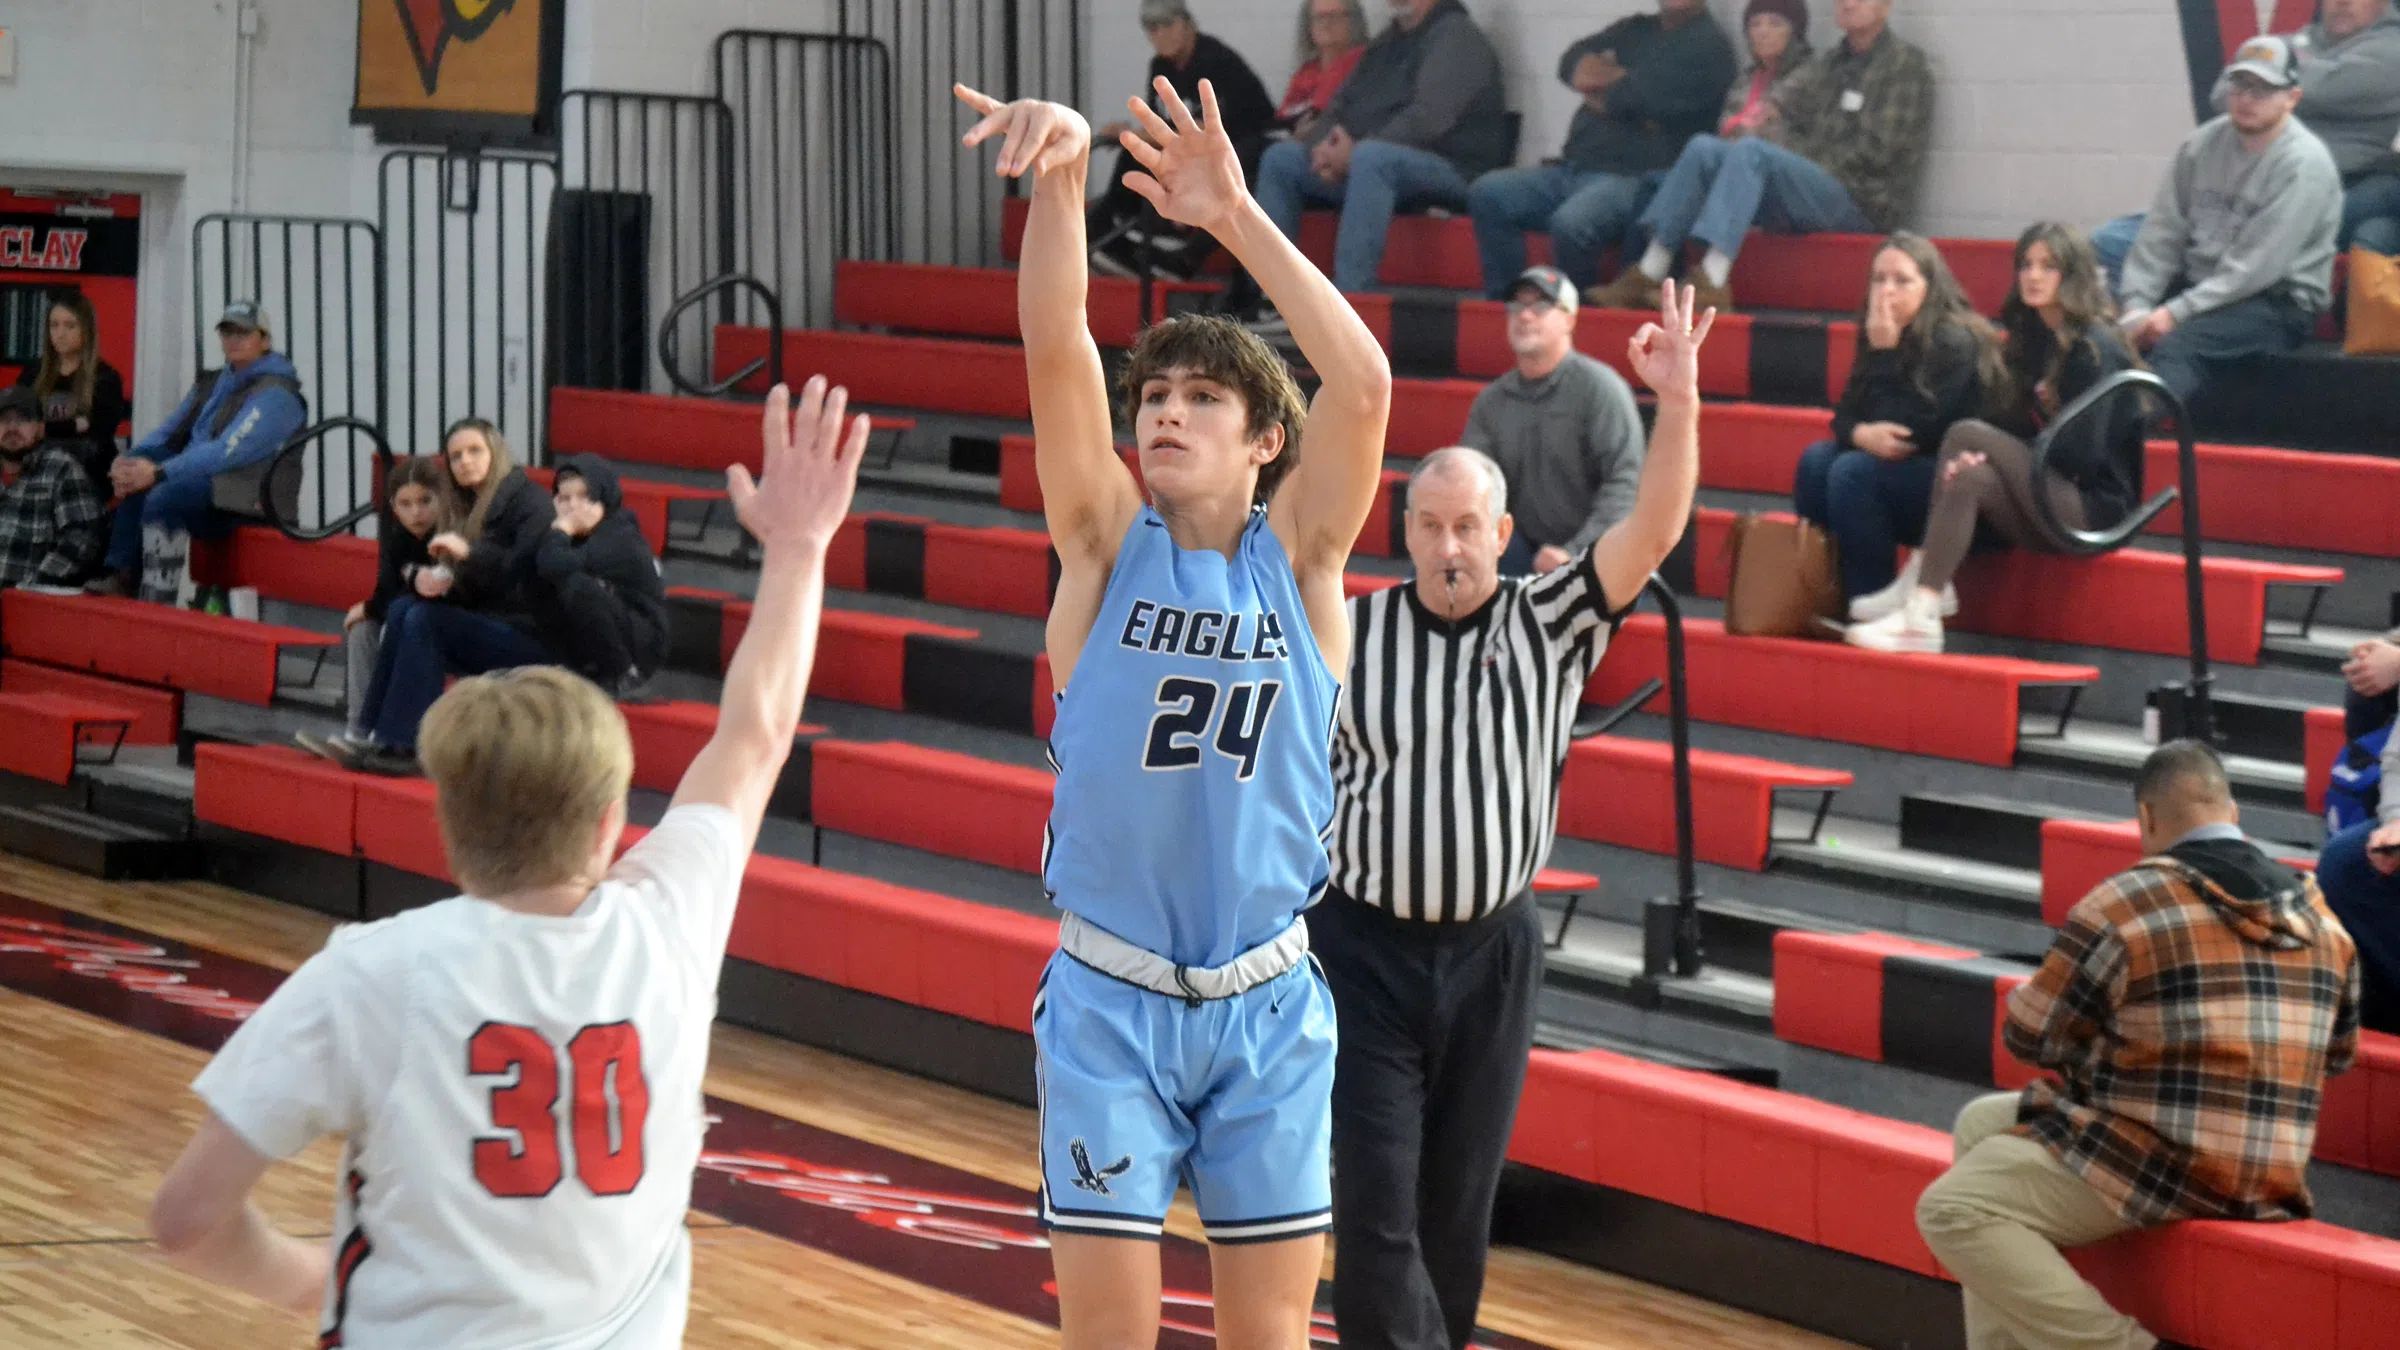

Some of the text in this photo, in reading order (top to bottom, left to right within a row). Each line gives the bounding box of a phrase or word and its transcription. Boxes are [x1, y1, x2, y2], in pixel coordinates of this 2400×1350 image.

[0, 225, 88, 271] CLAY
[1141, 675, 1283, 782] 24
[467, 1019, 650, 1198] 30
